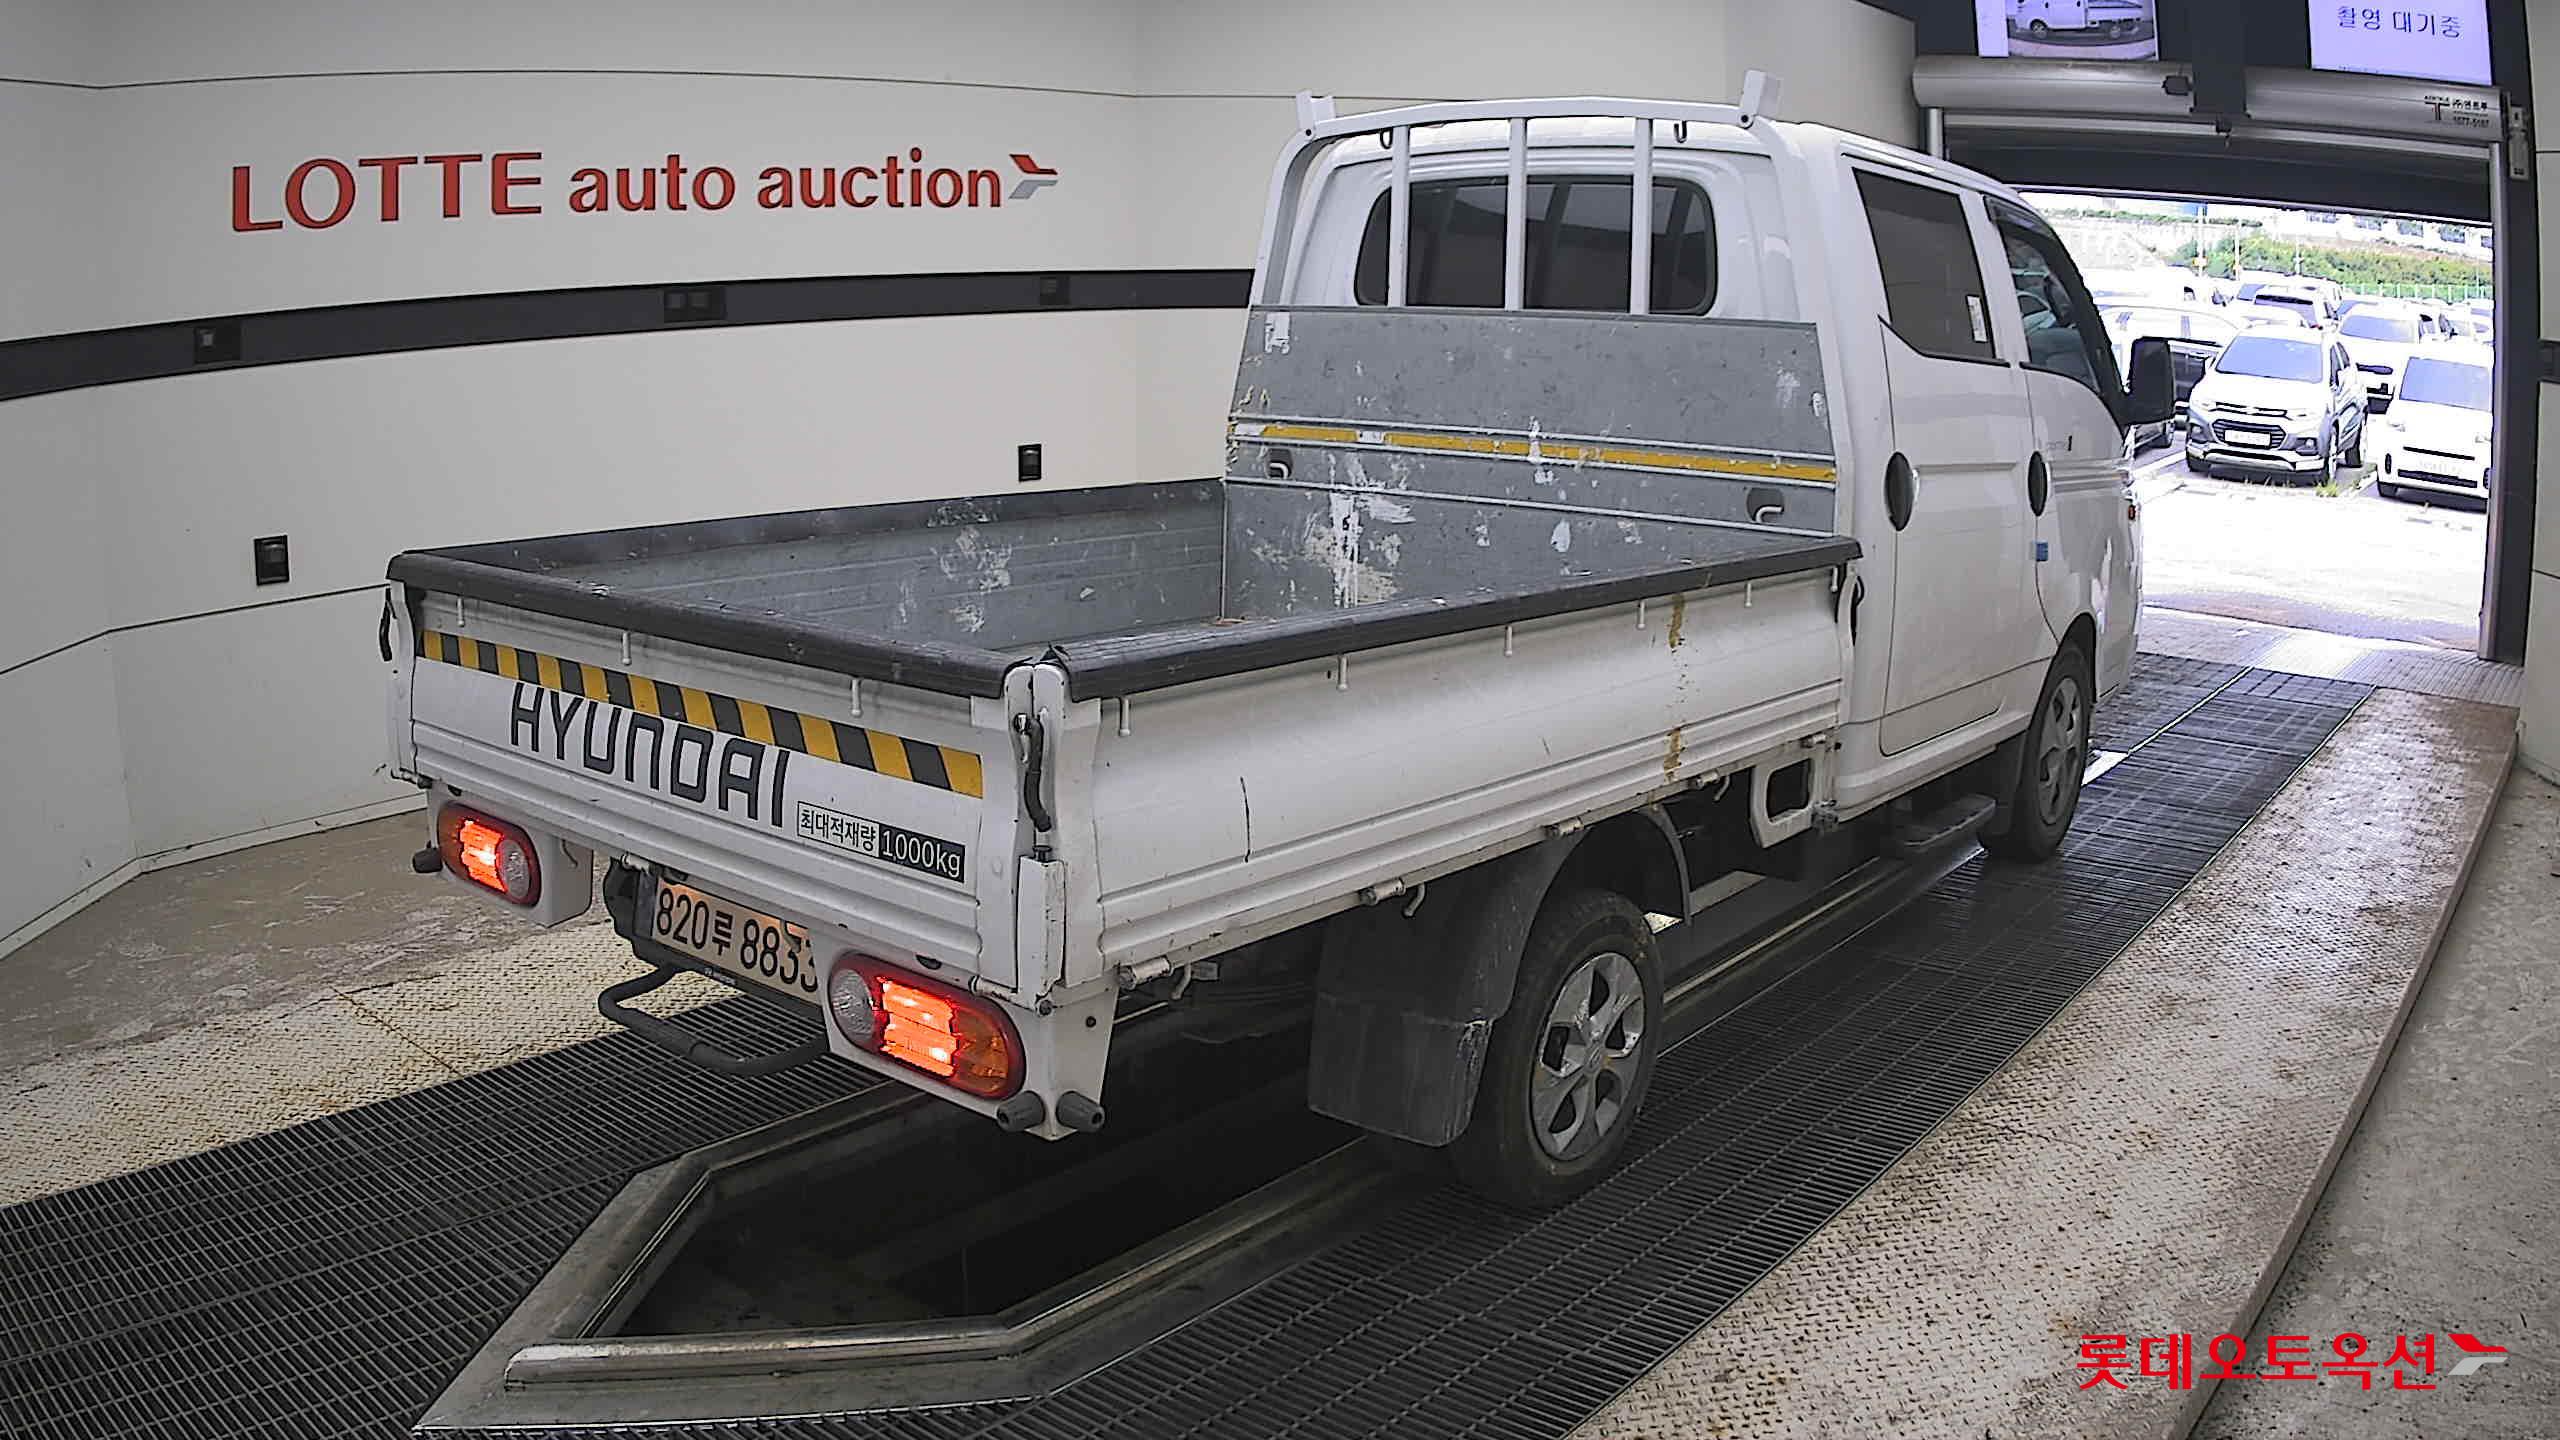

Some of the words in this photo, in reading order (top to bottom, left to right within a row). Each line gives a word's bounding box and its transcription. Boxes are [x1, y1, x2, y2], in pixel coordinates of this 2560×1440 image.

[2337, 6, 2382, 31] 촬영
[2392, 11, 2461, 39] 대기중
[232, 151, 543, 233] LOTTE
[568, 153, 737, 213] auto
[757, 147, 1003, 209] auction
[510, 681, 791, 829] HYUNDAI
[800, 808, 877, 853] 최대적재량
[656, 887, 734, 956] 820루
